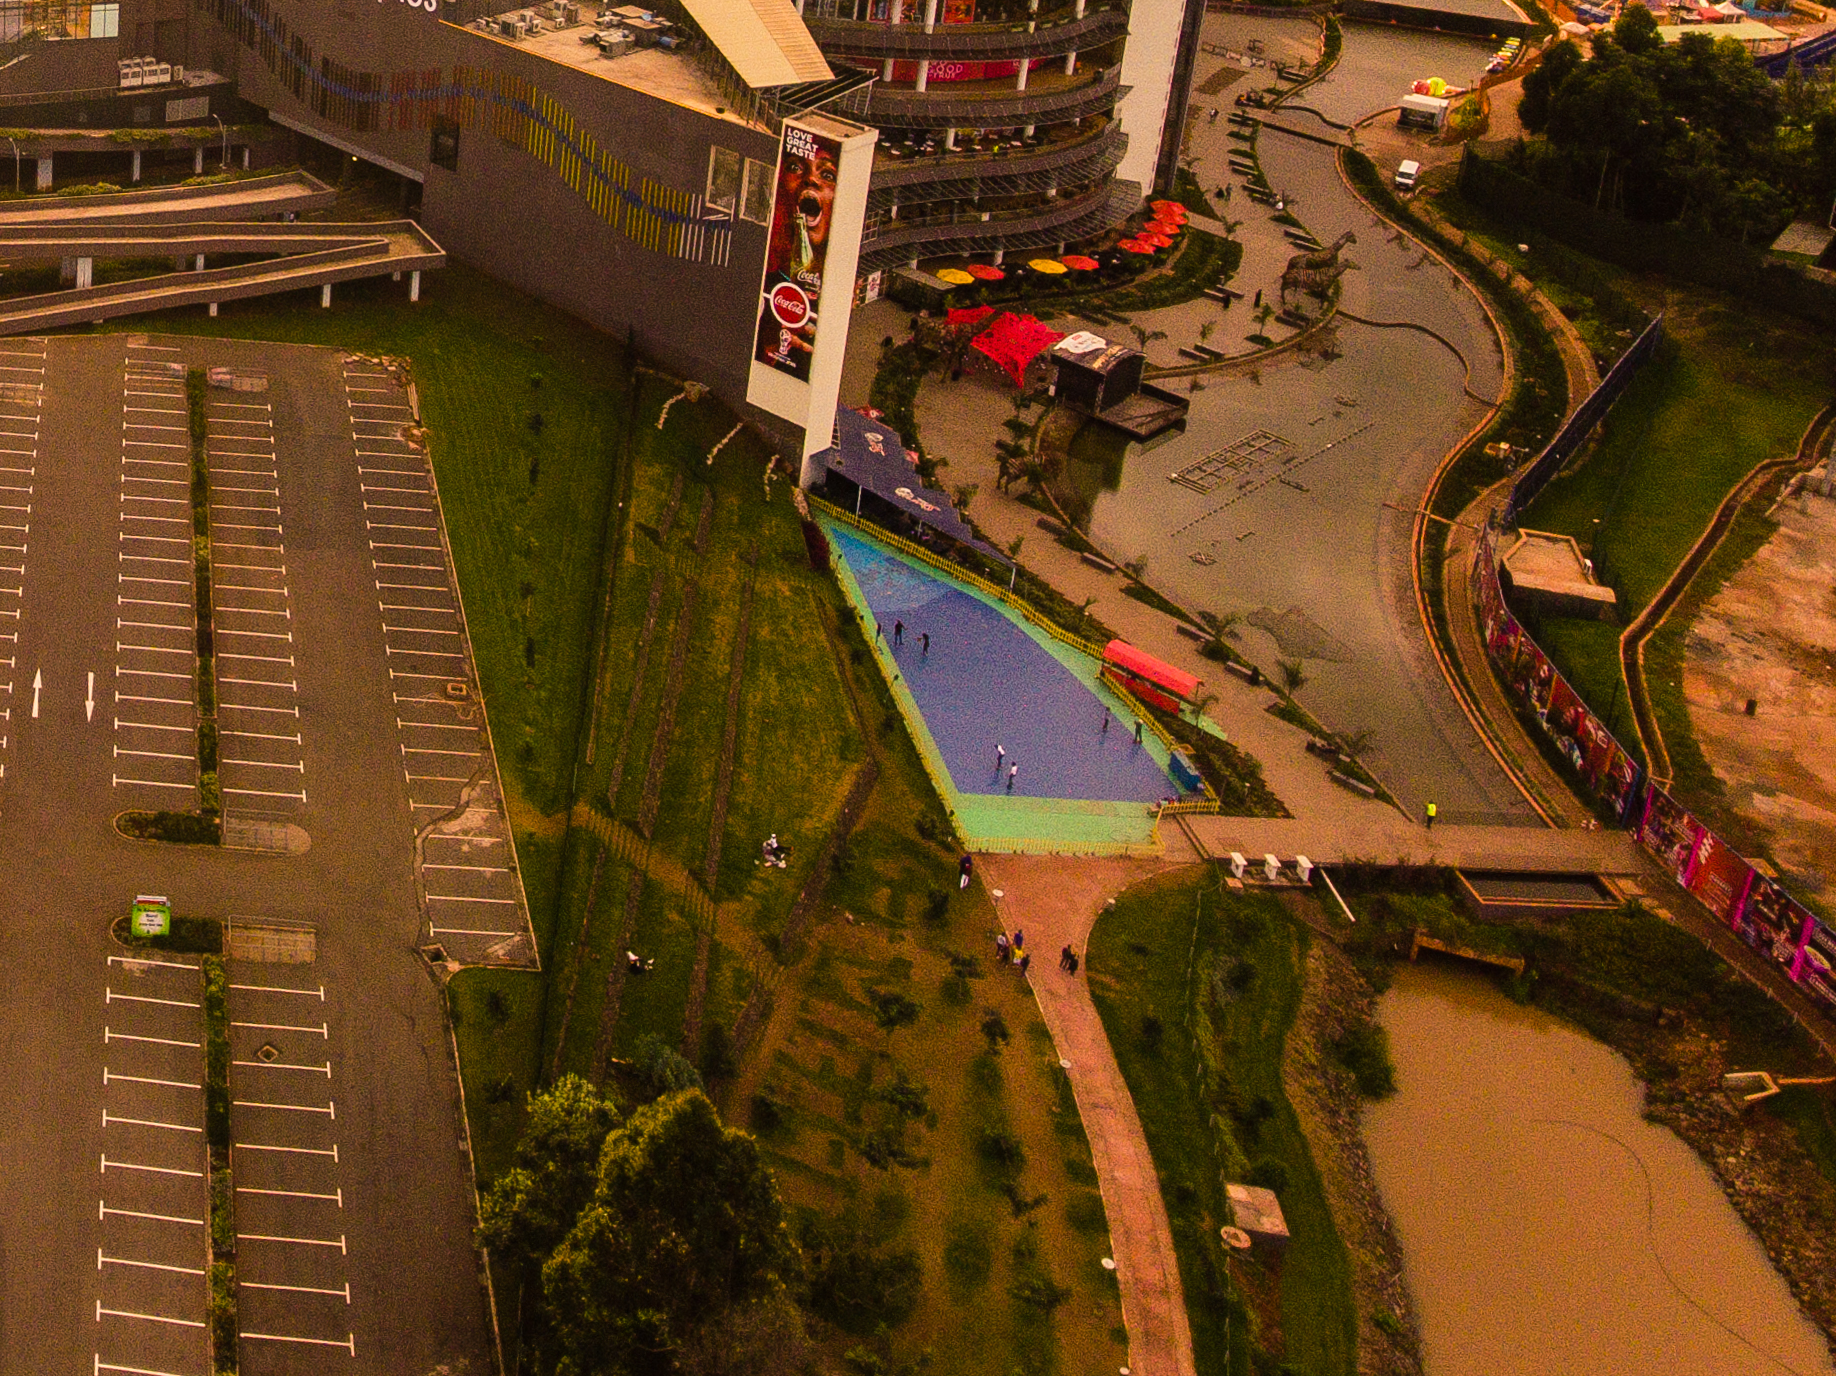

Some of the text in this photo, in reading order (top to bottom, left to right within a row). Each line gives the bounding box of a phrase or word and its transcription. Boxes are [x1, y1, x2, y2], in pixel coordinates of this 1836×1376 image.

[787, 127, 814, 143] LOVE
[785, 143, 816, 161] TASTE
[786, 136, 819, 153] GREAT
